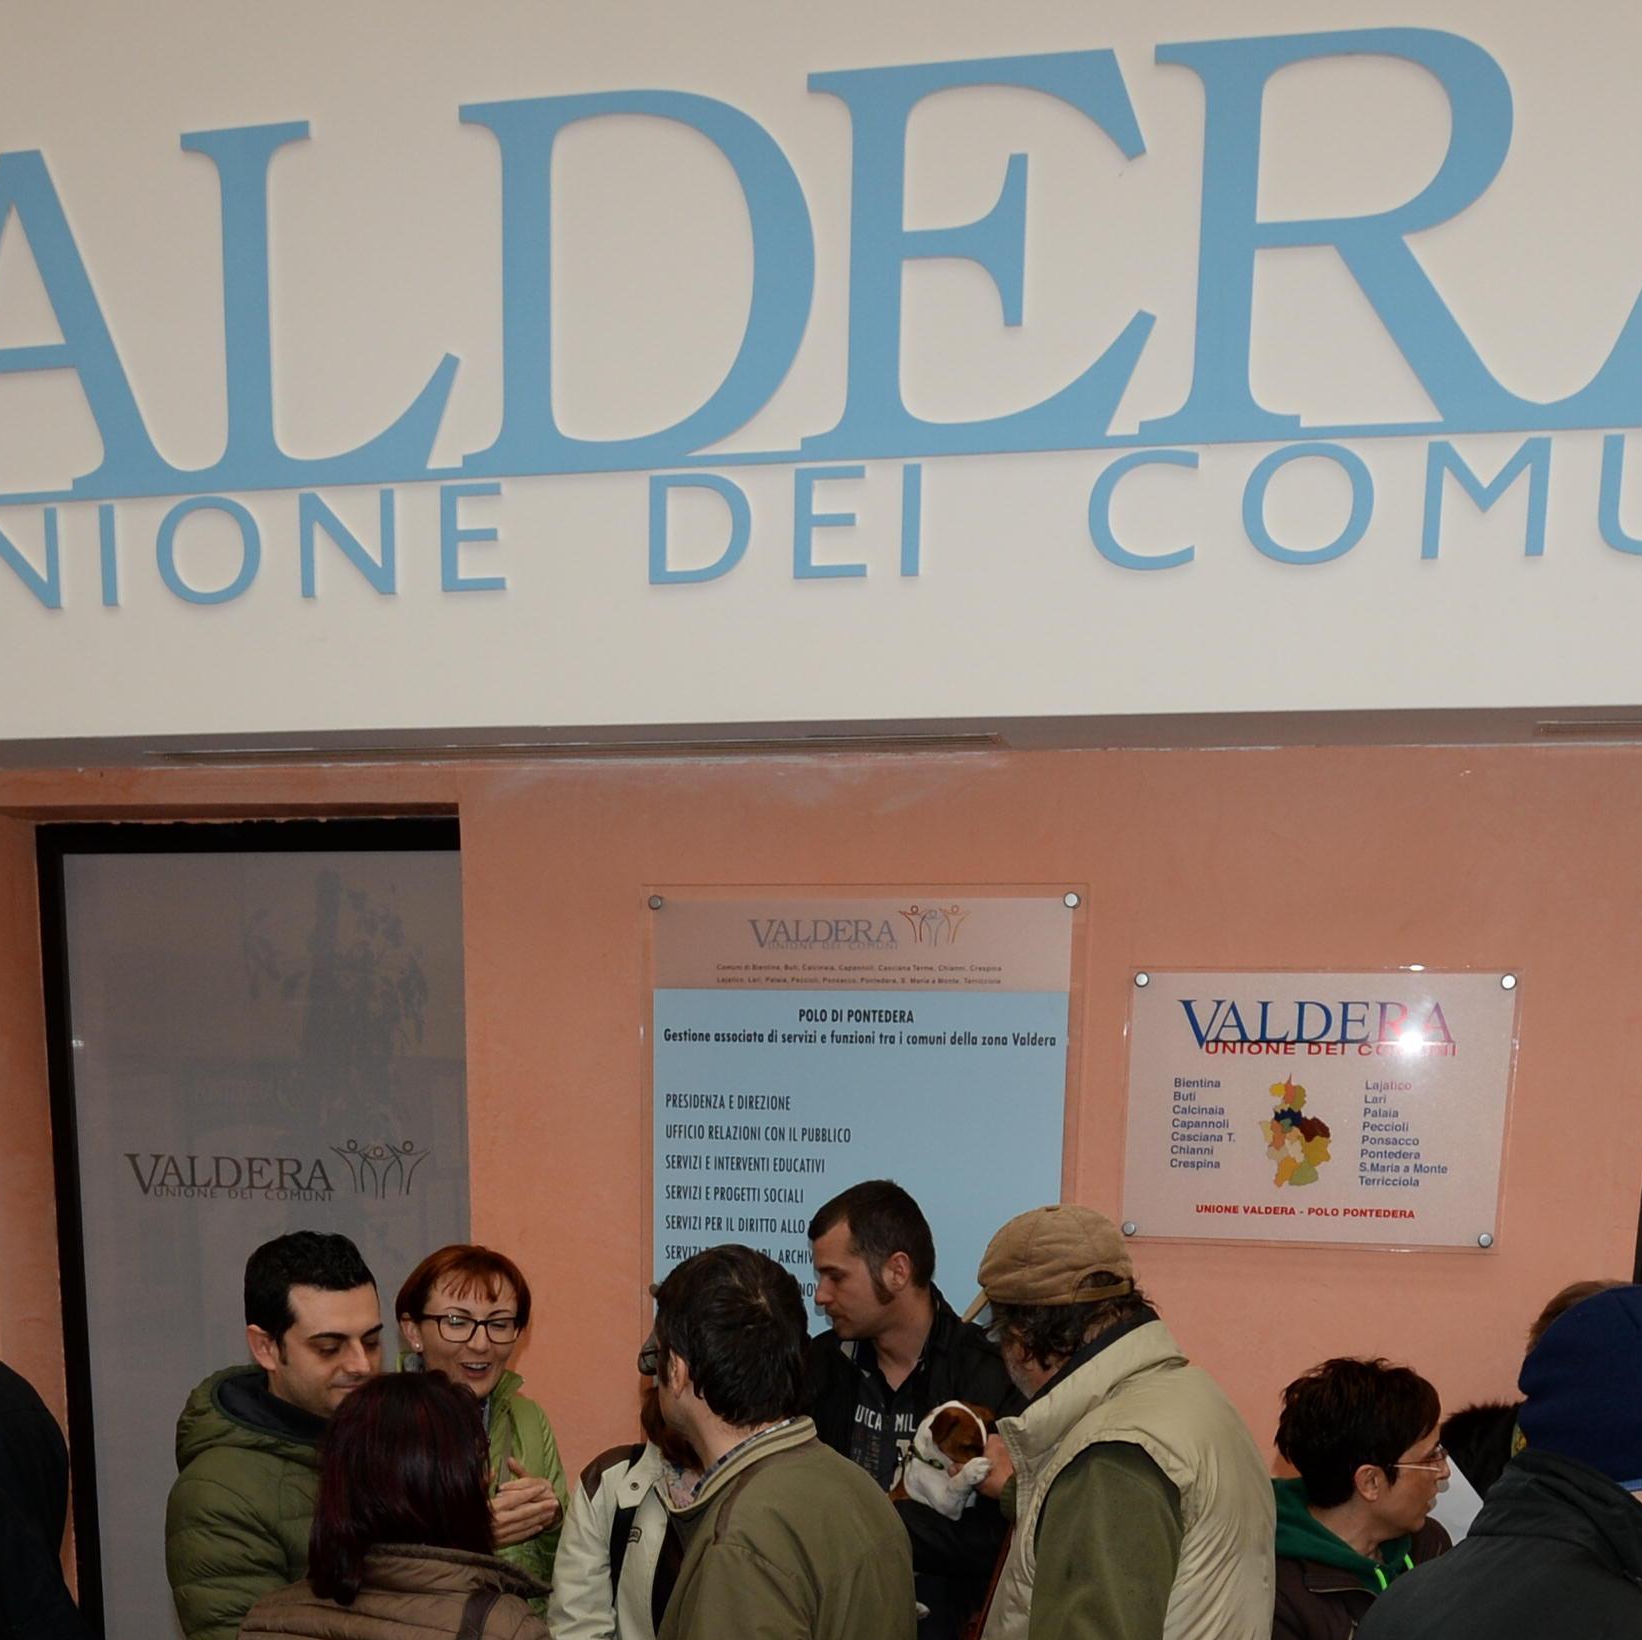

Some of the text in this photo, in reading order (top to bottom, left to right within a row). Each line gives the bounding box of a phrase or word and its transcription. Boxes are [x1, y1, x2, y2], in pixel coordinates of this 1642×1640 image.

[649, 463, 922, 585] DEI
[747, 918, 897, 948] VALDERA
[799, 1008, 914, 1024] POLO DI PONTEDERA
[1177, 999, 1456, 1049] VALDERA
[663, 1028, 1056, 1047] Gestione associata di servizi e funzioni tra i comuni della zona Valdera
[1205, 1040, 1296, 1055] UNIONE
[1307, 1041, 1345, 1056] DEI
[1174, 1077, 1221, 1088] Bientina
[1365, 1080, 1412, 1092] Lajatico
[665, 1093, 791, 1111] PRESIDENZA E DIREZIONE
[1173, 1091, 1196, 1101] Buti
[1364, 1094, 1387, 1104] Lari
[1172, 1105, 1225, 1115] Calcinaia
[1363, 1107, 1399, 1118] Palaia
[1172, 1118, 1229, 1130] Capannoli
[1362, 1121, 1409, 1132] Peccioli
[665, 1124, 851, 1143] UFFICIO RELAZIONI CON IL PUBBLICO
[1171, 1132, 1236, 1143] Casciana T.
[1361, 1135, 1420, 1146] Ponsacco
[1170, 1145, 1214, 1155] Chianni
[1360, 1148, 1421, 1160] Pontedera
[665, 1154, 825, 1173] SERVIZI E INTERVENTI EDUCATIVI
[1170, 1158, 1221, 1170] Crespina
[1403, 1165, 1410, 1173] a
[1413, 1163, 1448, 1174] Monte
[124, 1153, 335, 1195] VALDERA
[1358, 1176, 1420, 1187] Terricciola
[154, 1186, 332, 1202] UNIONE DEI COMUNI
[665, 1185, 804, 1203] SERVIZI E PROGETTI SOCIALI
[1195, 1204, 1239, 1214] UNIONE
[1243, 1205, 1296, 1215] VALDERA
[1307, 1207, 1339, 1217] POLO
[1343, 1208, 1415, 1219] PONTEDERA
[665, 1215, 805, 1234] SERVIZI PER IL DIRITTO ALLO
[778, 1250, 814, 1264] ARCHIV
